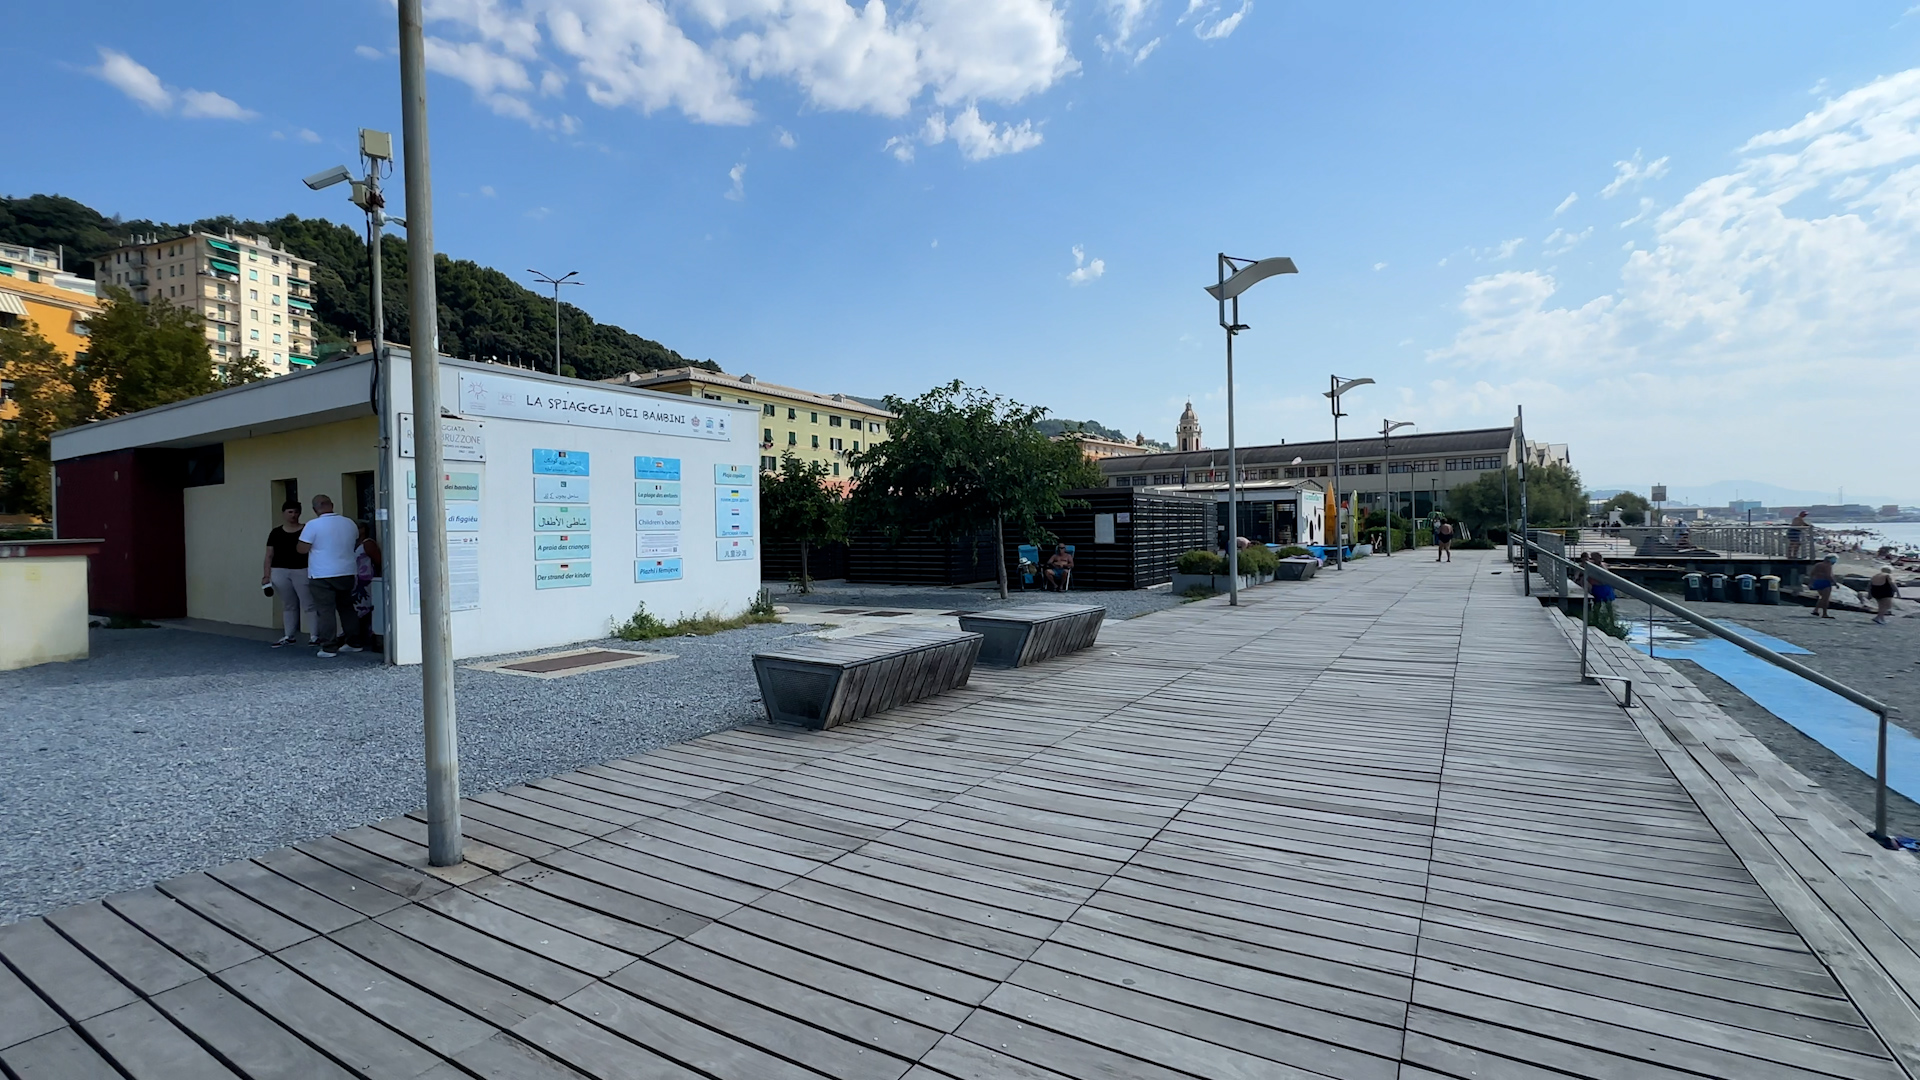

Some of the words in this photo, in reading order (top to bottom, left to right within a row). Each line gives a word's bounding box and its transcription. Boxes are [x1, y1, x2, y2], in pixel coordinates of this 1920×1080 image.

[526, 394, 543, 408] LA
[548, 398, 614, 416] SPIAGGIA
[619, 407, 639, 419] DEI
[642, 410, 686, 424] BAMBINI
[567, 544, 590, 552] crianças
[574, 571, 591, 579] kinder
